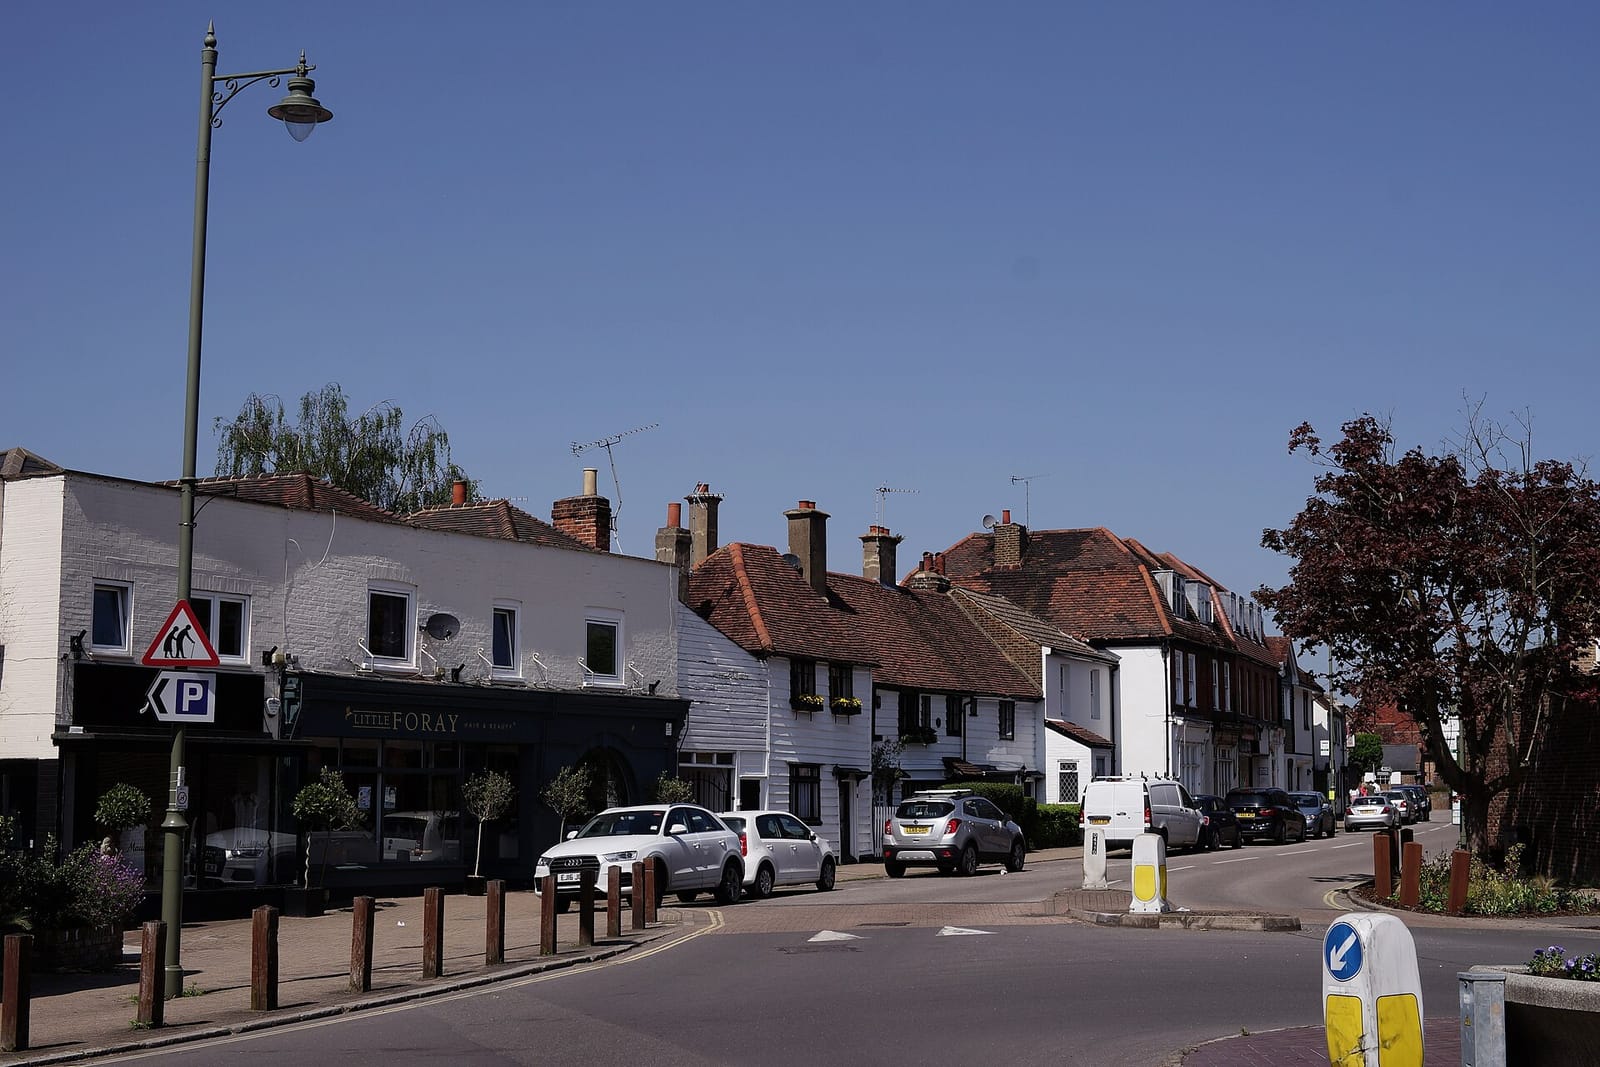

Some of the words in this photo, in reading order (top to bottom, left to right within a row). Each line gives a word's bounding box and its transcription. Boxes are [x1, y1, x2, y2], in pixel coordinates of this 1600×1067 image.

[182, 682, 203, 712] P
[353, 714, 390, 726] LITTLE
[392, 712, 459, 732] FORAY
